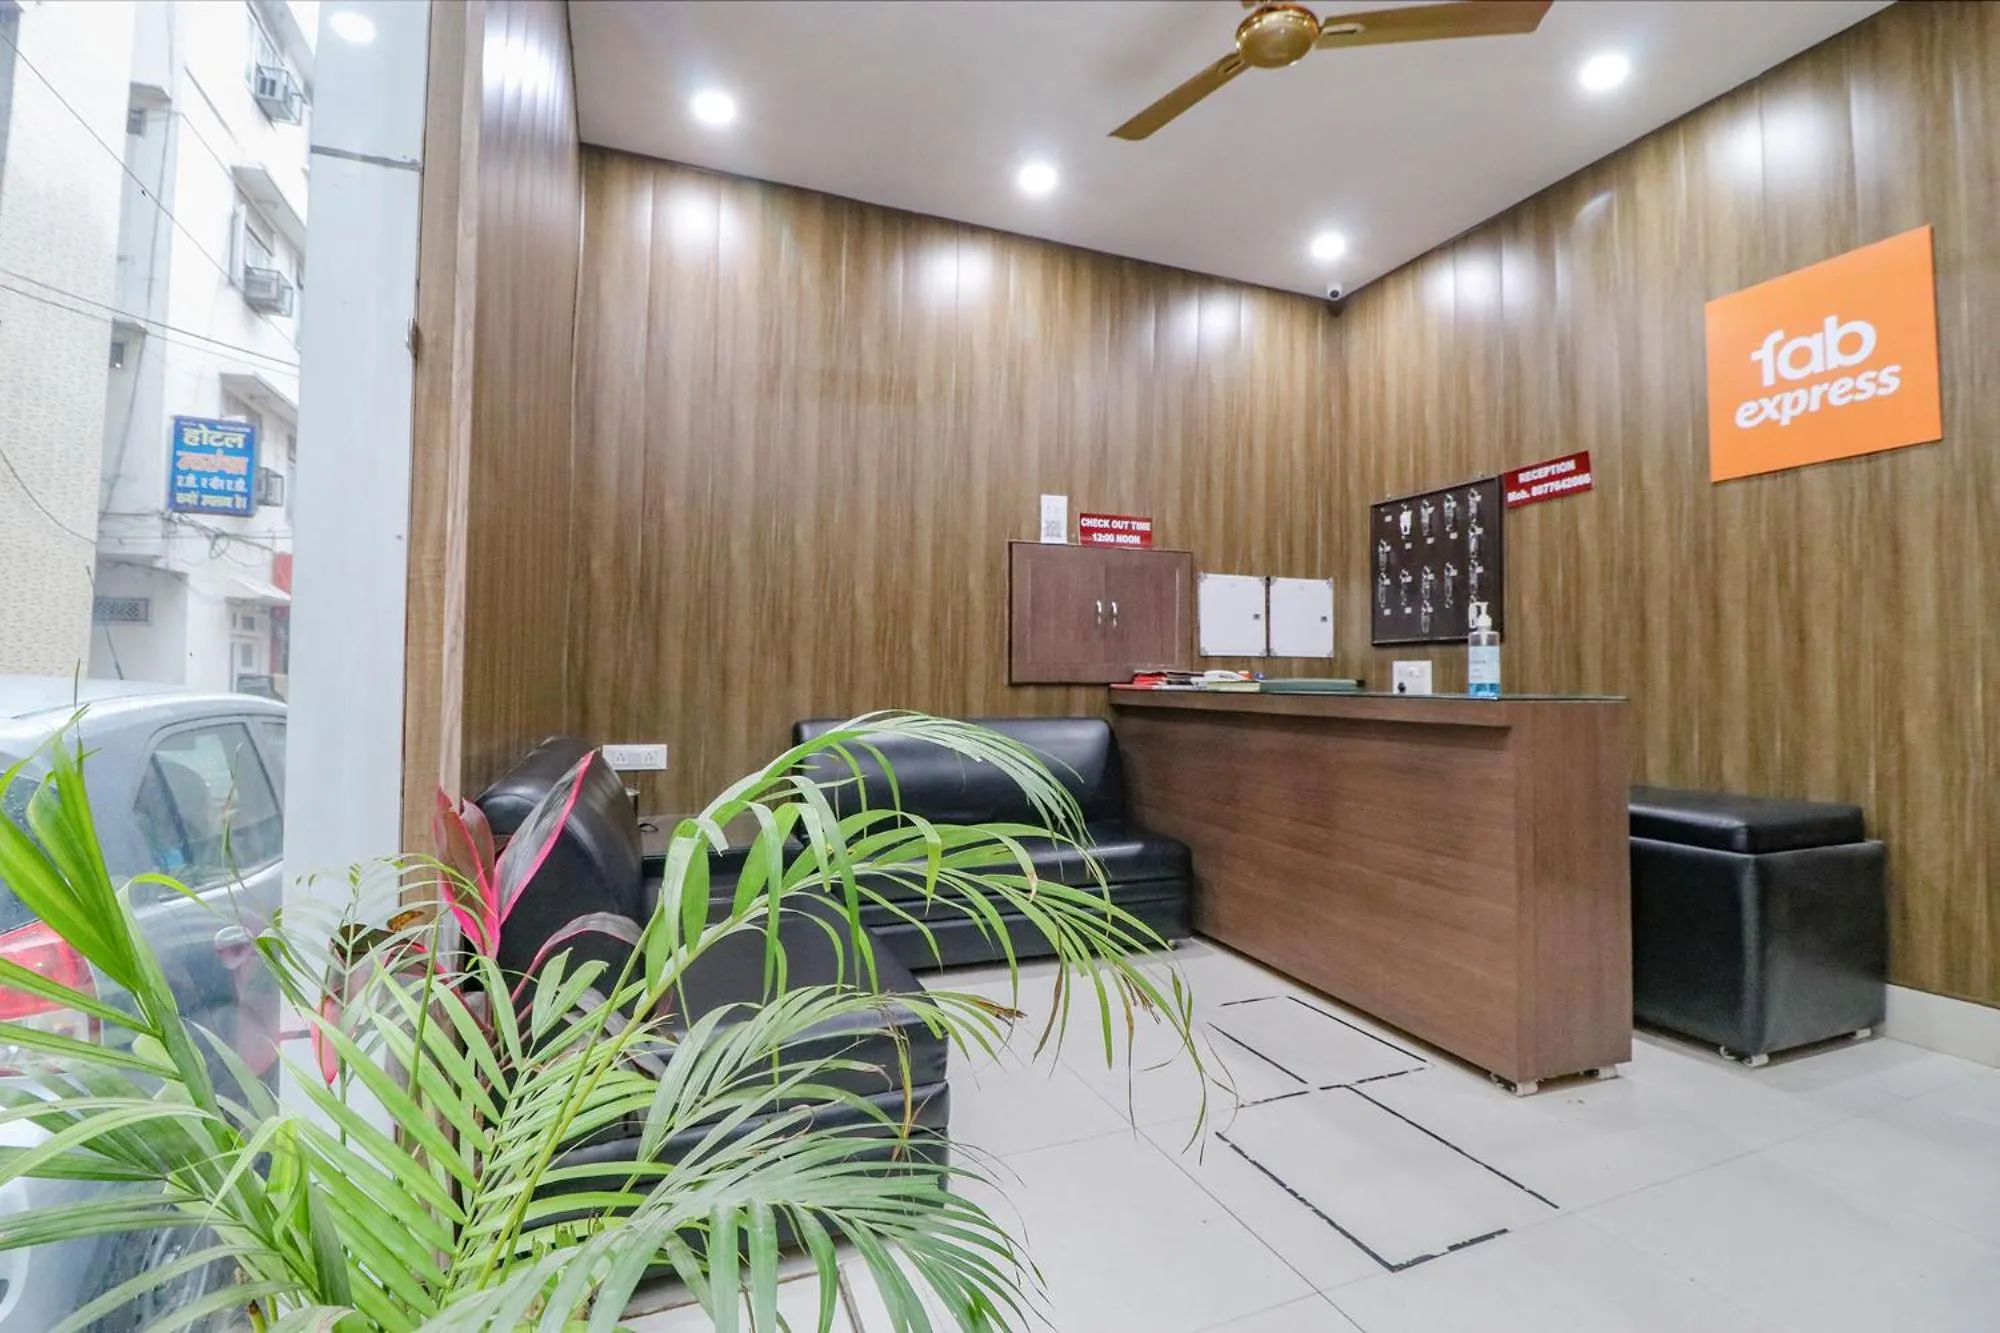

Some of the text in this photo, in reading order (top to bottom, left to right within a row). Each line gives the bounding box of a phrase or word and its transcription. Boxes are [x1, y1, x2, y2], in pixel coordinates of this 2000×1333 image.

[1751, 315, 1877, 387] fab
[1735, 364, 1902, 428] express
[183, 424, 247, 448] होटल
[1518, 459, 1576, 483] RECEPTION
[1080, 517, 1151, 531] CHECK OUT TIME
[1115, 535, 1141, 544] NOON
